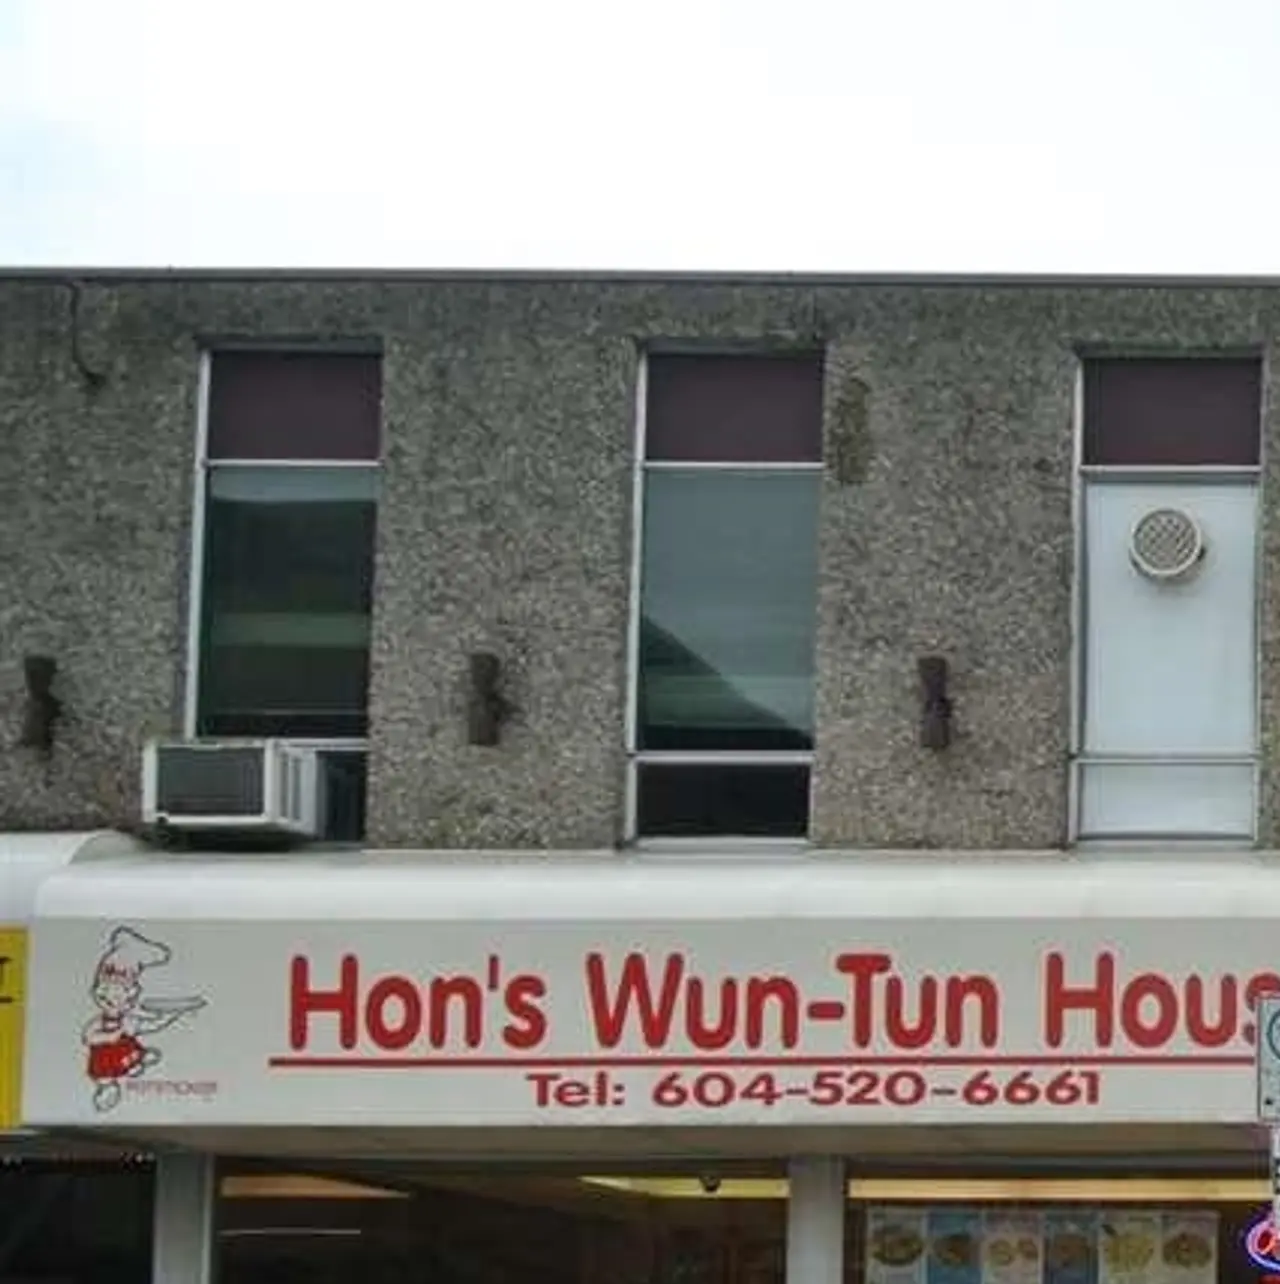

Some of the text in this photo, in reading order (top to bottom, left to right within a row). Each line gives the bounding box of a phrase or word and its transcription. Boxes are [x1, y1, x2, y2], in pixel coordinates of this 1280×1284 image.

[289, 953, 547, 1051] Hon's
[586, 952, 999, 1050] Wun-Tun
[526, 1069, 1099, 1109] Tel: 604-520-6661
